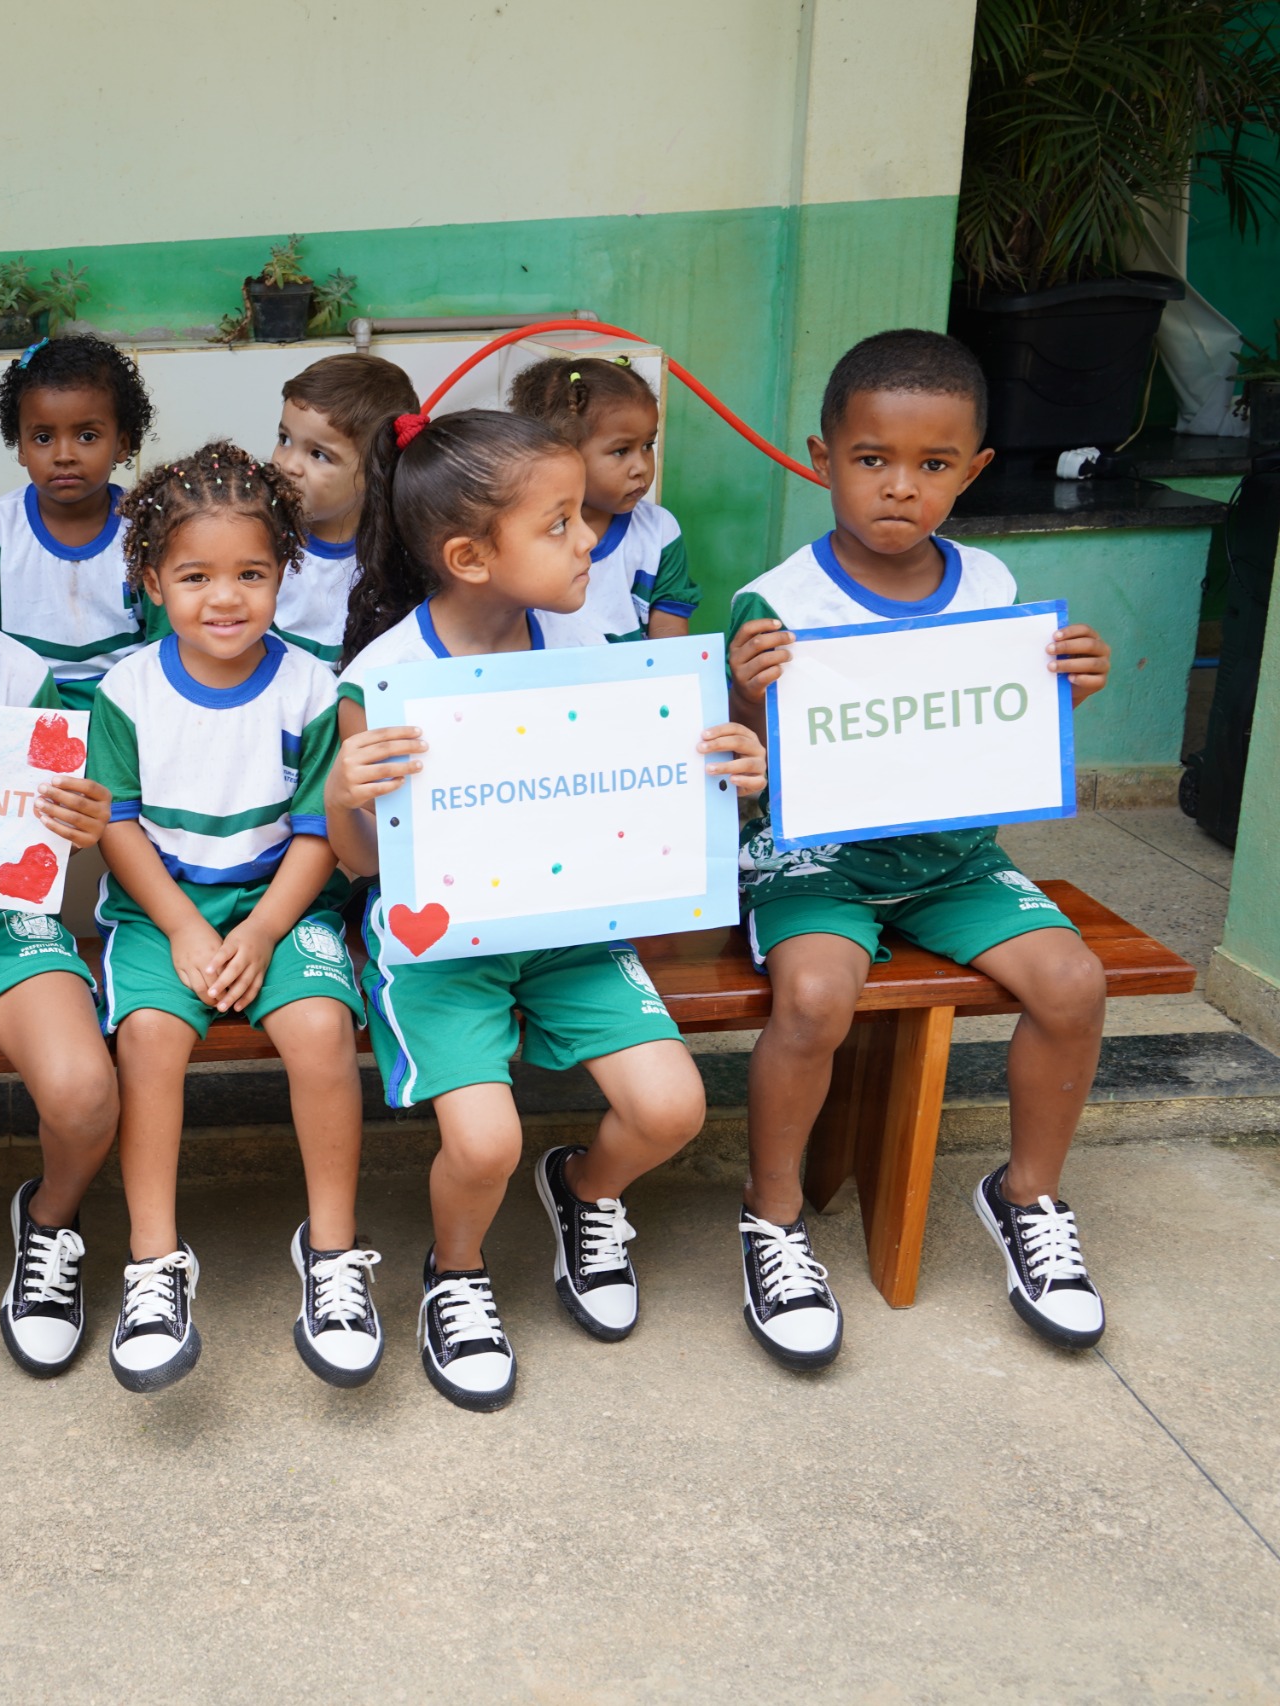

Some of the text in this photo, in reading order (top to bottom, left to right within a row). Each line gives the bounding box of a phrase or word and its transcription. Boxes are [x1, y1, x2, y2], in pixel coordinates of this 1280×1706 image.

[807, 682, 1029, 746] RESPEITO
[431, 762, 689, 811] RESPONSABILIDADE
[19, 948, 38, 957] SÃO
[20, 942, 59, 953] PREFEITURA
[303, 969, 323, 978] SÃO
[641, 1005, 661, 1014] SÃO
